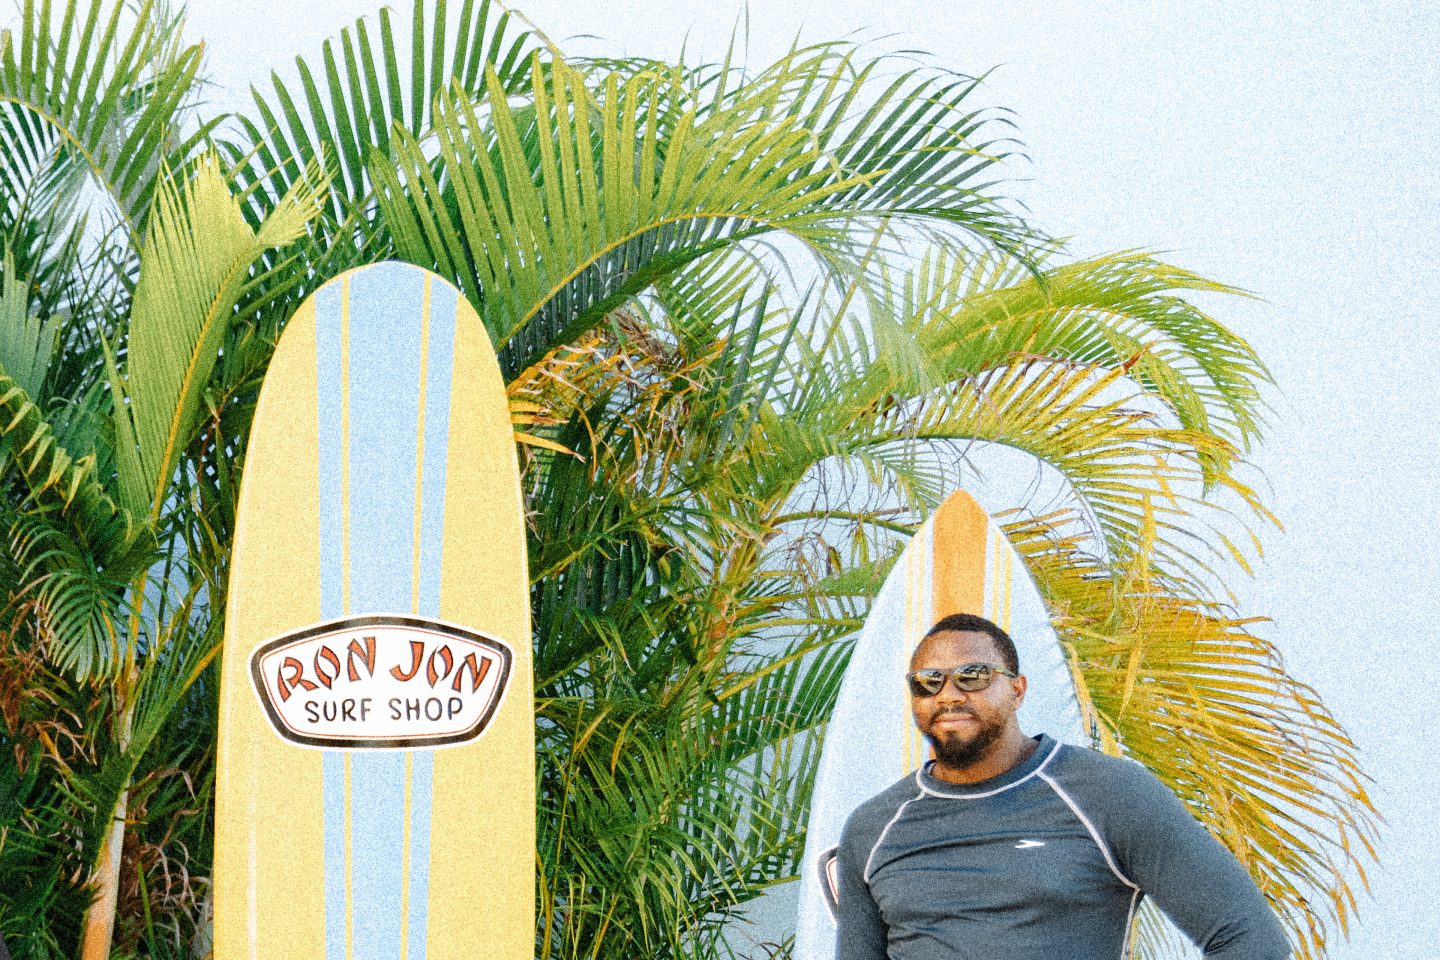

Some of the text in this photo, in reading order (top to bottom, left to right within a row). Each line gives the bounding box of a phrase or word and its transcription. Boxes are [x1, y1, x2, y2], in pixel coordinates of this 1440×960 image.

[276, 636, 492, 703] RON JON
[304, 696, 464, 723] SURF SHOP
